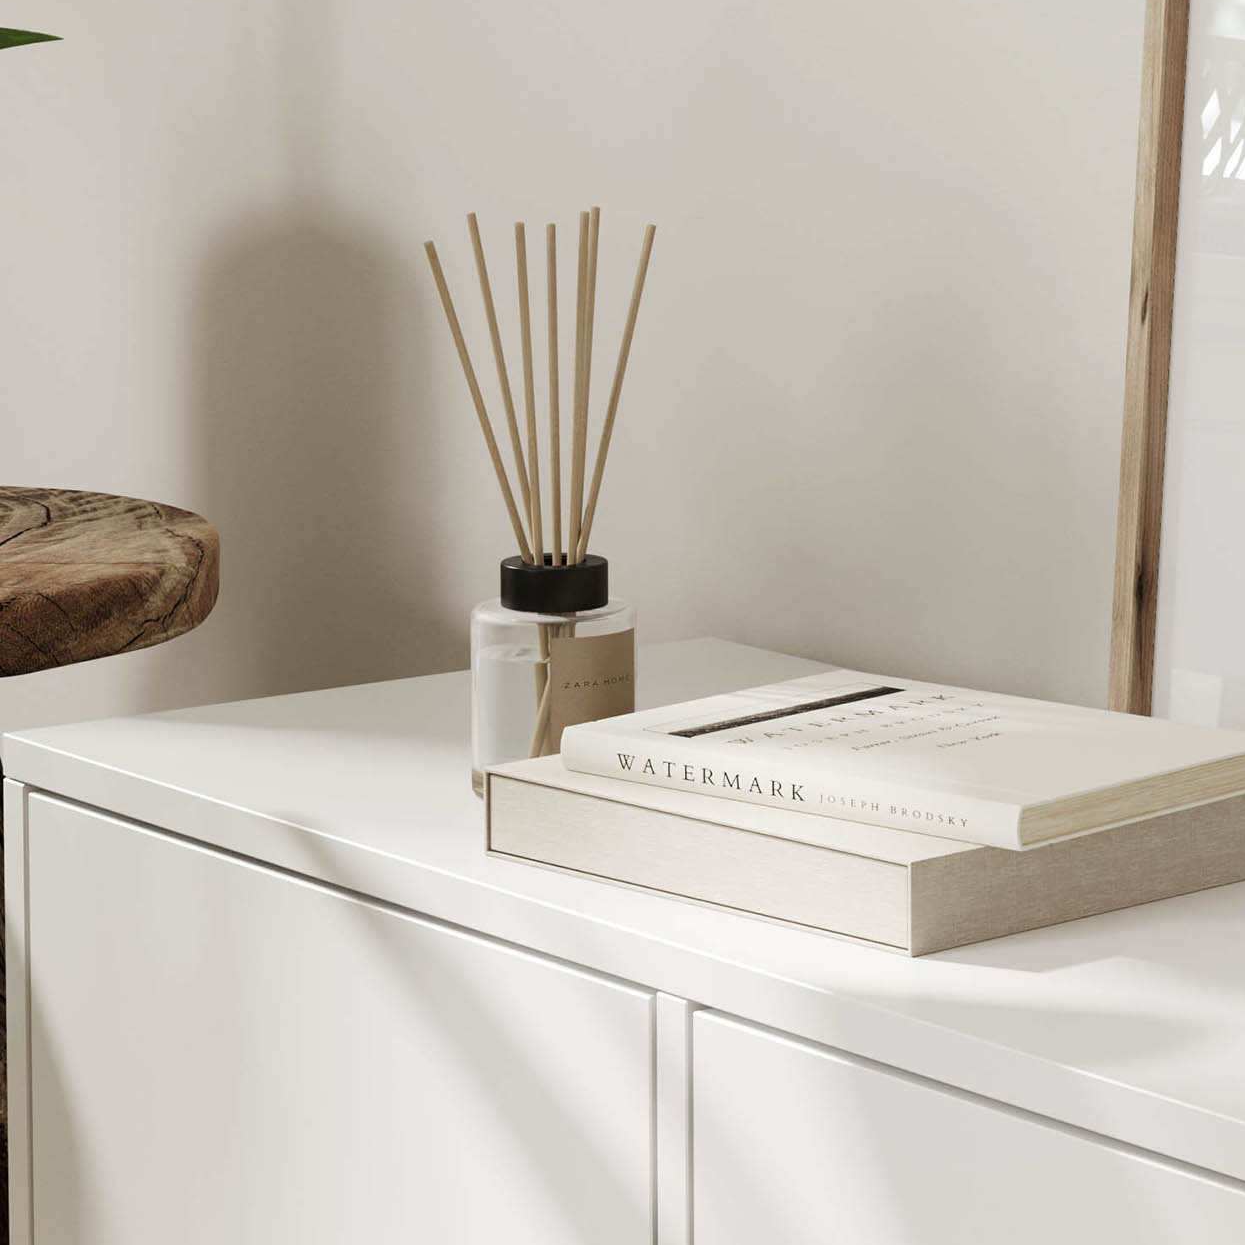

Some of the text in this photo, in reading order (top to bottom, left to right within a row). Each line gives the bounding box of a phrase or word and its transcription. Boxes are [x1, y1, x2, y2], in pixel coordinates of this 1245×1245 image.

[562, 680, 599, 690] ZARA
[616, 753, 968, 827] WATERMARK JOSEPH BRODSKY
